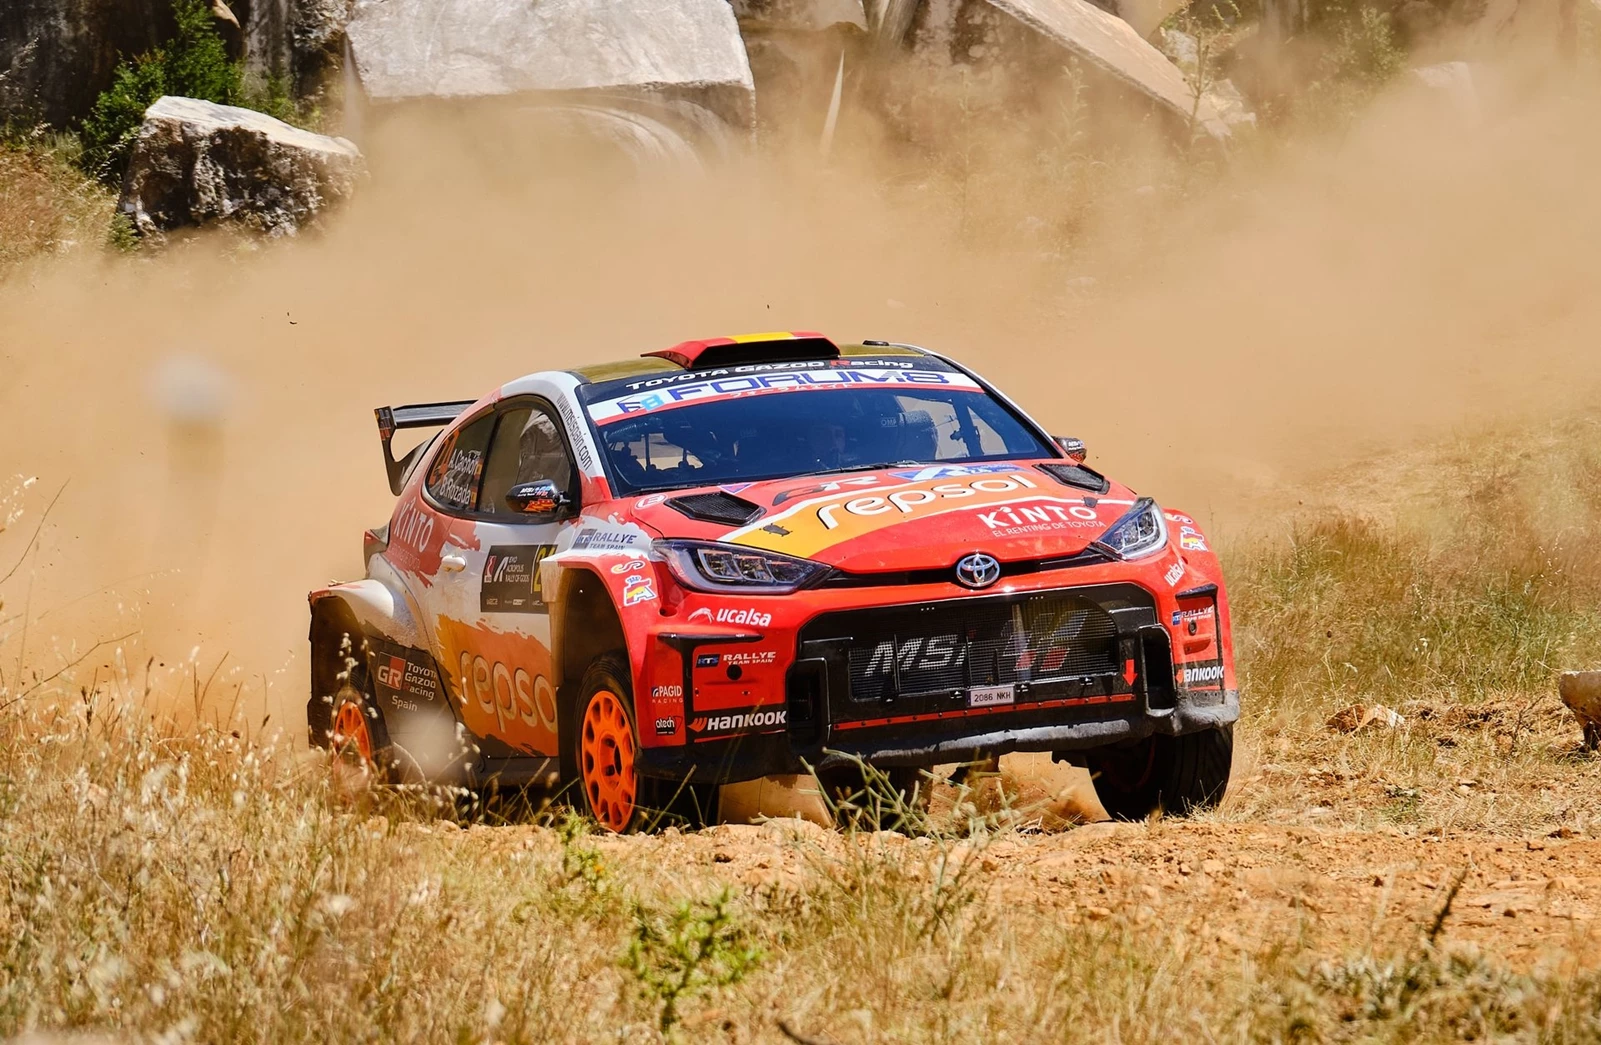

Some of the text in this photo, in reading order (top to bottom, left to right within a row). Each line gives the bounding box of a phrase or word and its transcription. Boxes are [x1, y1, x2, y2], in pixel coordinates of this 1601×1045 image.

[626, 369, 728, 390] TOYOTA
[829, 359, 914, 369] Racing
[667, 371, 949, 401] FORUM8
[817, 474, 1037, 530] repsol
[592, 532, 638, 544] RALLYE
[992, 520, 1107, 538] EL RENTING DE TOYOTA
[716, 608, 772, 627] ucalsa
[723, 651, 776, 661] RALLYE
[378, 662, 437, 688] GR TOYOTA
[404, 672, 436, 689] GAZOO
[403, 682, 435, 701] Racing
[460, 650, 558, 734] repso
[659, 685, 682, 697] PAGID
[996, 691, 1011, 700] NKH
[391, 695, 418, 712] Spain
